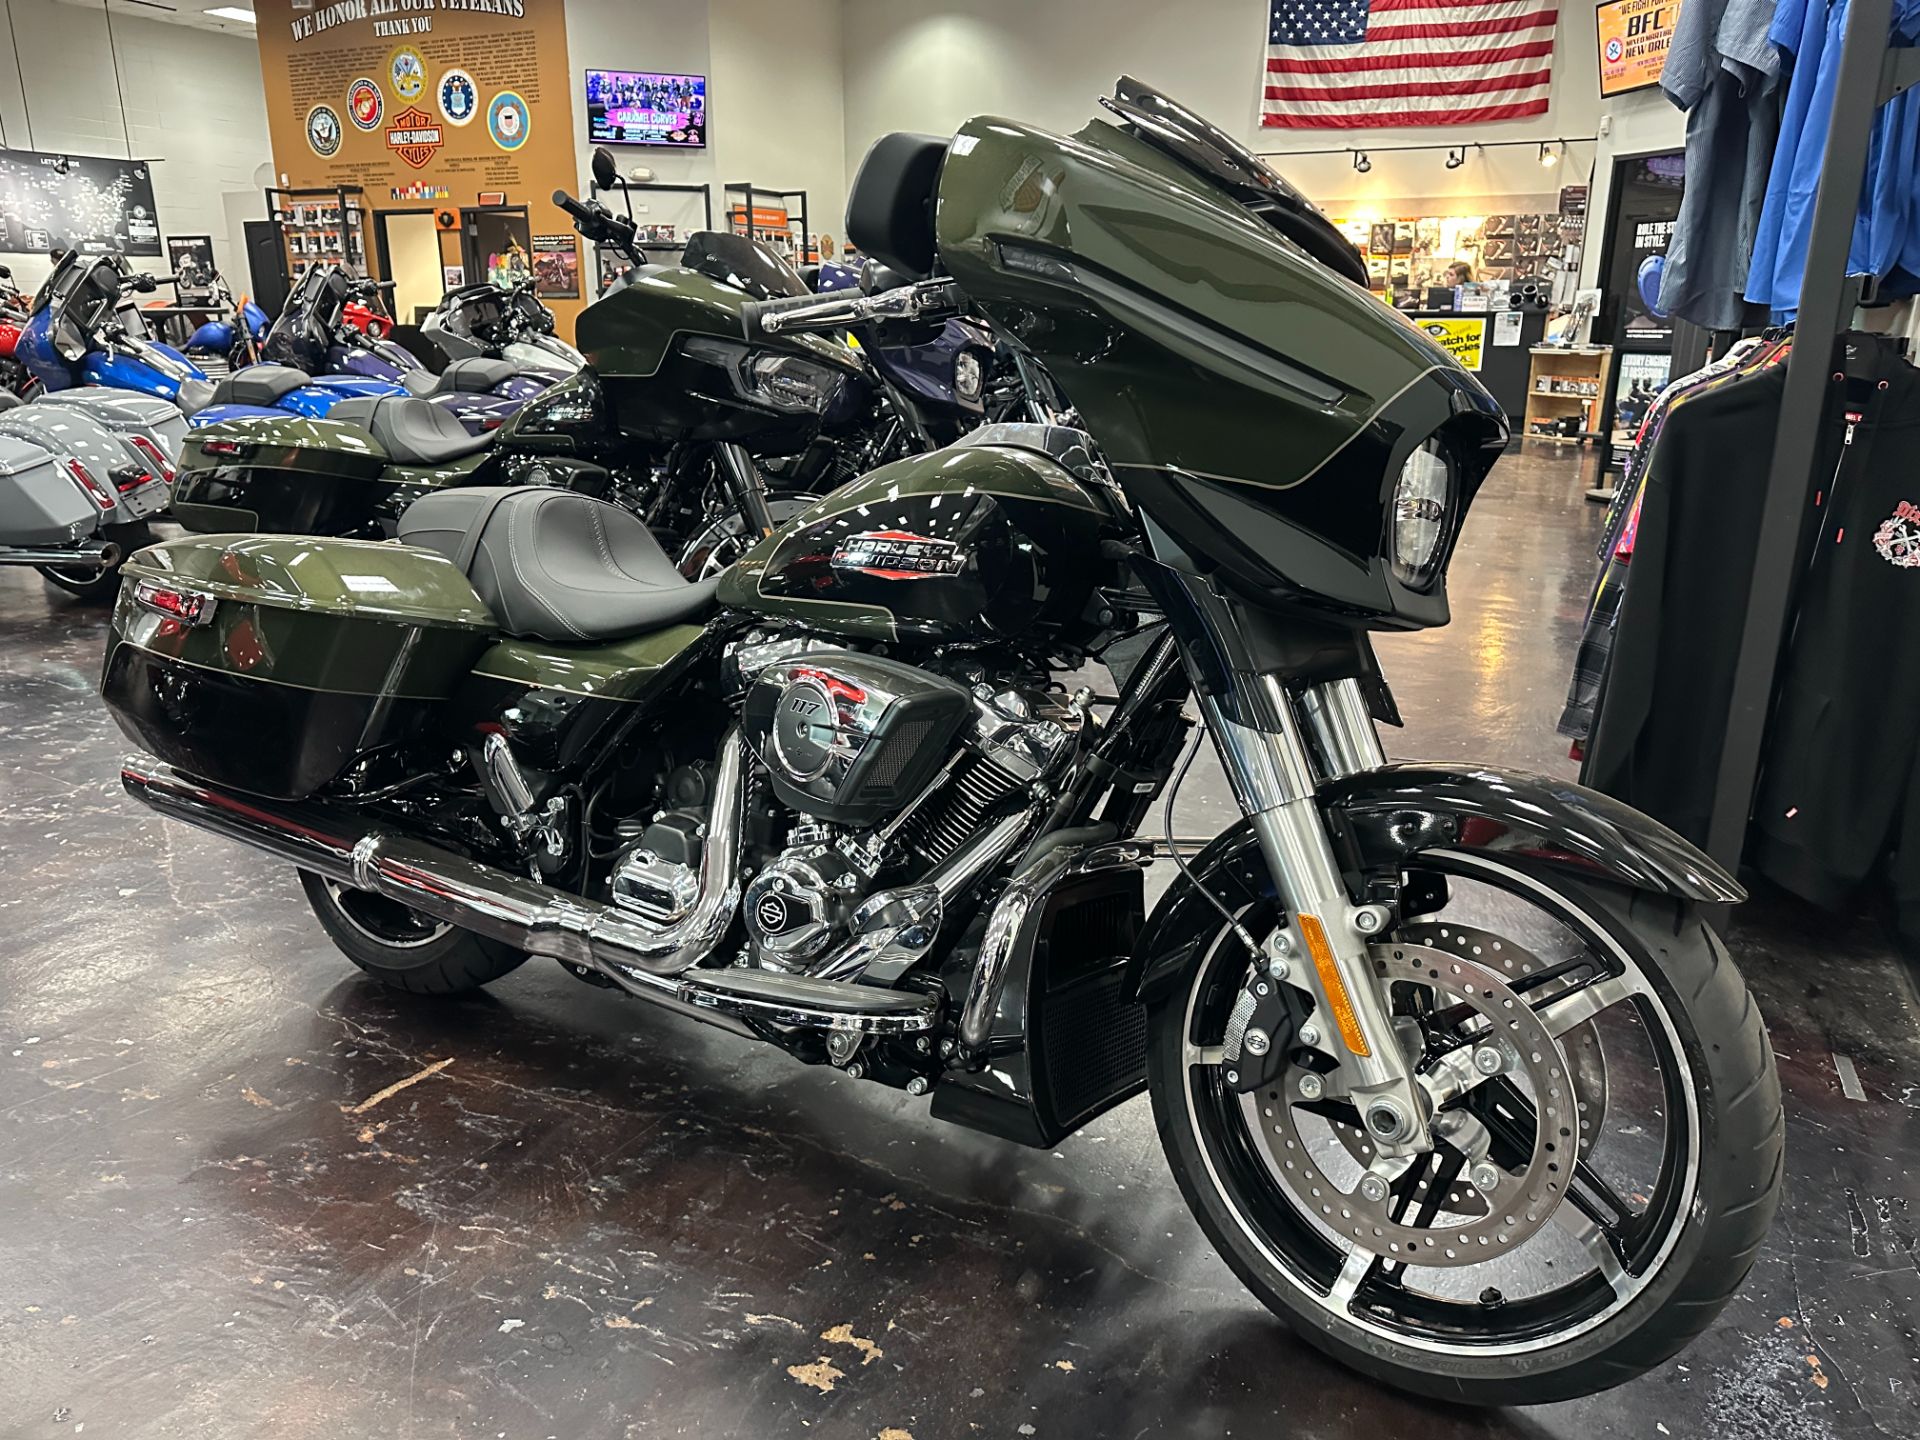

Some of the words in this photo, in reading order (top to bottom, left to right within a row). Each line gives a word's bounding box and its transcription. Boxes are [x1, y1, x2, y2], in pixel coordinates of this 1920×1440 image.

[291, 15, 313, 42] WE
[315, 0, 367, 32] HONOR
[373, 19, 410, 37] THANK
[411, 16, 432, 33] YOU
[1628, 8, 1666, 37] BFC
[1626, 43, 1648, 59] NEW
[400, 113, 426, 128] MOTOR
[389, 129, 440, 145] HARLEY-DAVIDSON
[403, 146, 429, 163] CYCLES
[1637, 223, 1654, 235] RULE
[1654, 222, 1667, 234] THE
[1635, 235, 1644, 248] IN
[1466, 333, 1481, 342] for
[790, 697, 822, 717] 117
